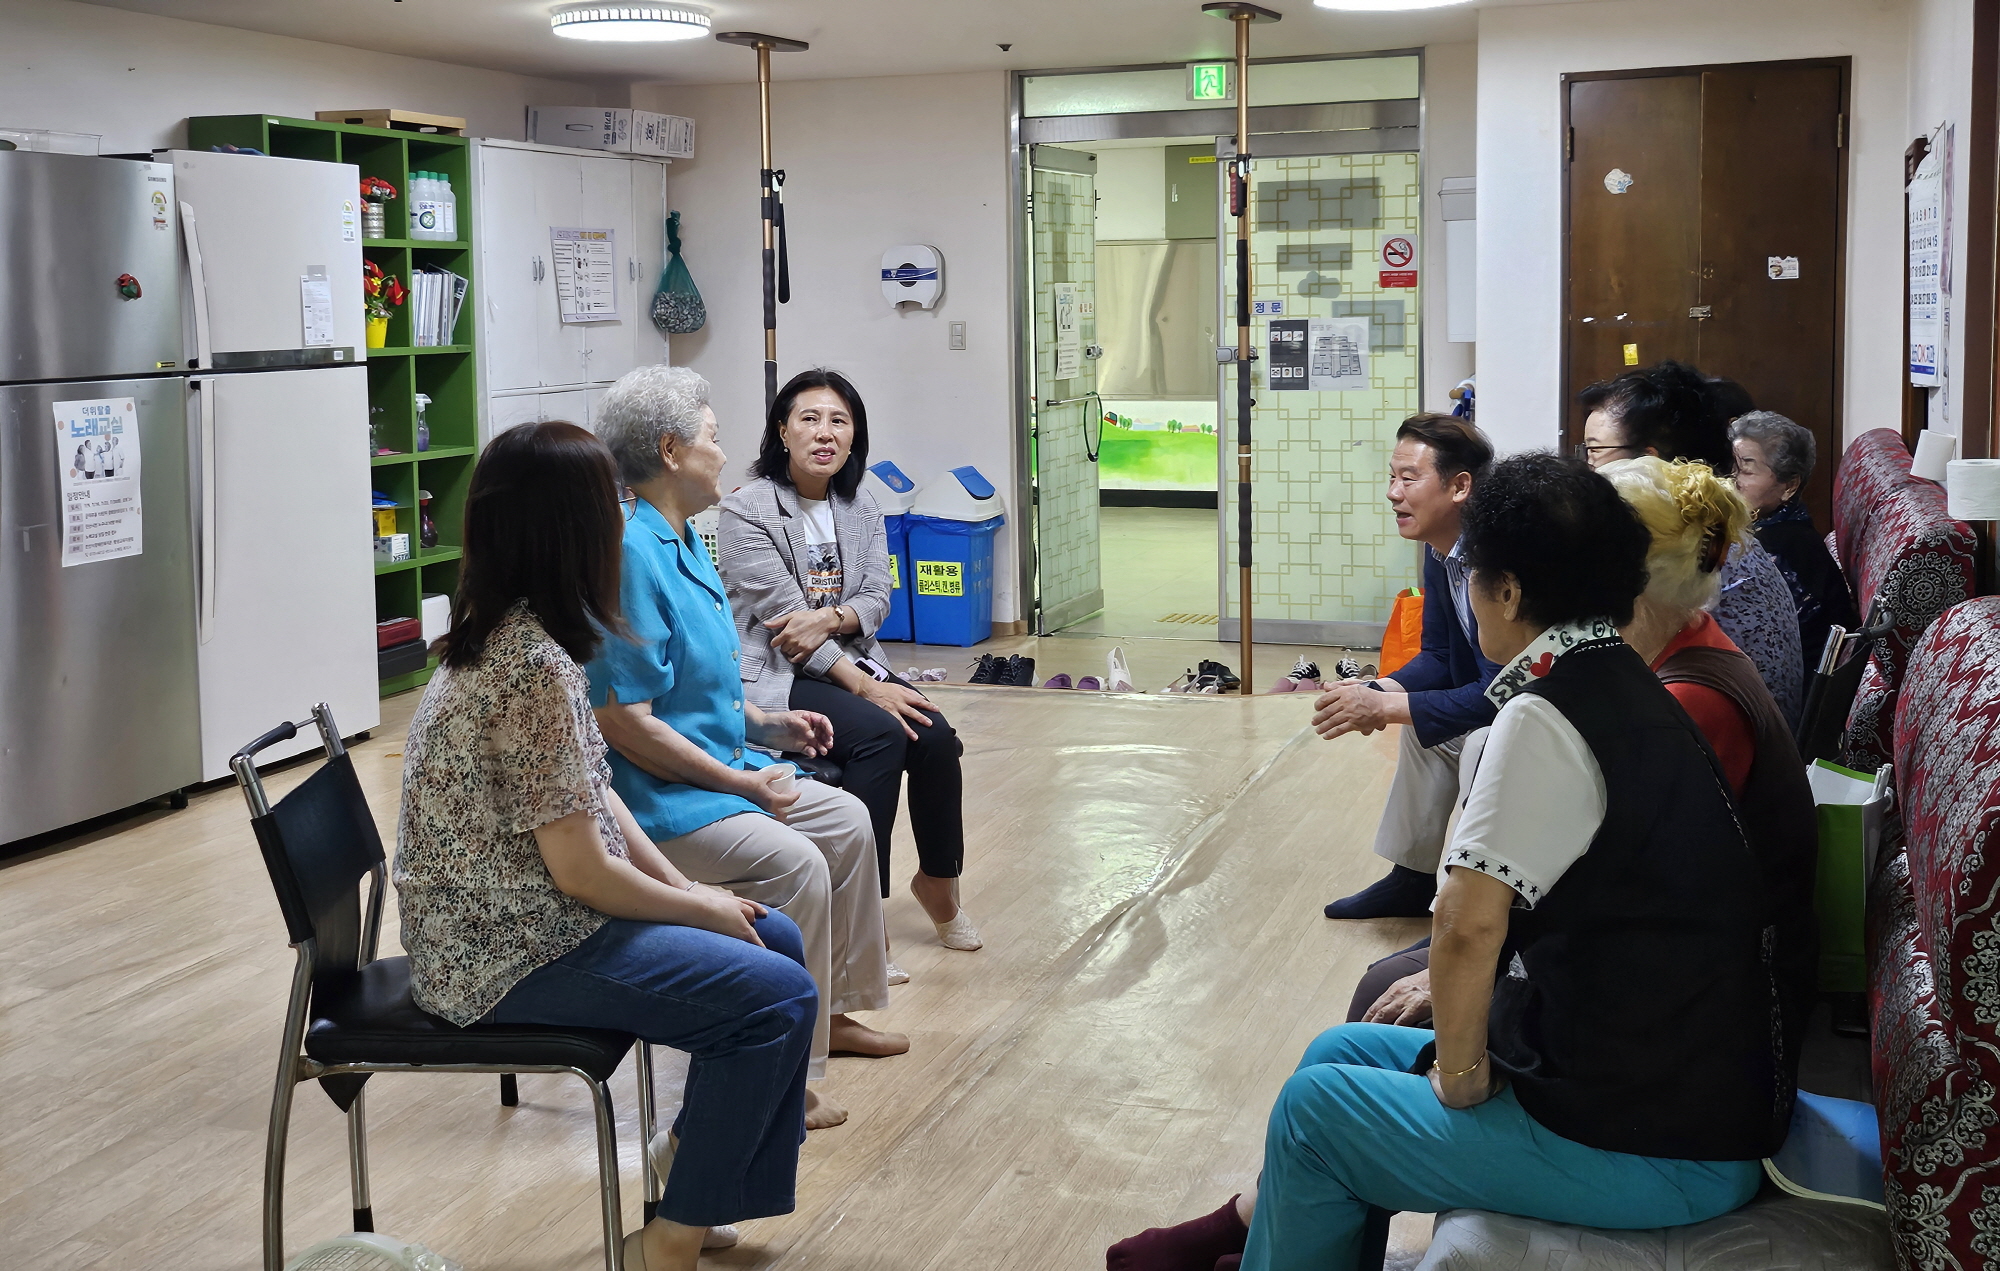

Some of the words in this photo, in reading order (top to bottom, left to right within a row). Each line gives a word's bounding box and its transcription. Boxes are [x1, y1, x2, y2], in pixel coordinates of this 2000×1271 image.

[1932, 235, 1937, 247] 15
[1932, 264, 1938, 275] 22
[82, 405, 111, 416] 더위탈출
[71, 416, 123, 438] 노래교실
[920, 564, 958, 576] 재활용
